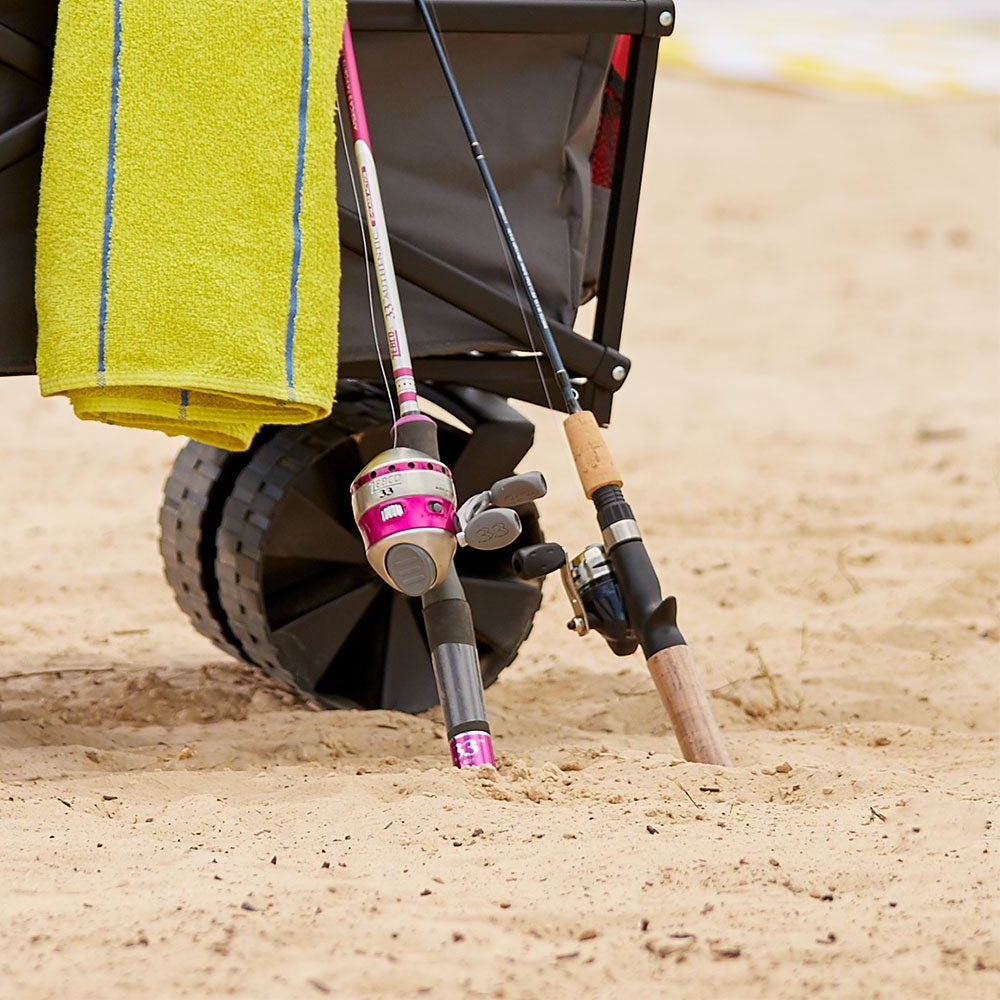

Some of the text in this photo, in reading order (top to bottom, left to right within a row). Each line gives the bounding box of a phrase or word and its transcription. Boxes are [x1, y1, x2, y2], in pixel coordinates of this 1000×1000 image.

[373, 231, 401, 360] ZEBCO 33 AUTHENTIC
[379, 487, 394, 498] 33
[475, 522, 509, 543] 33
